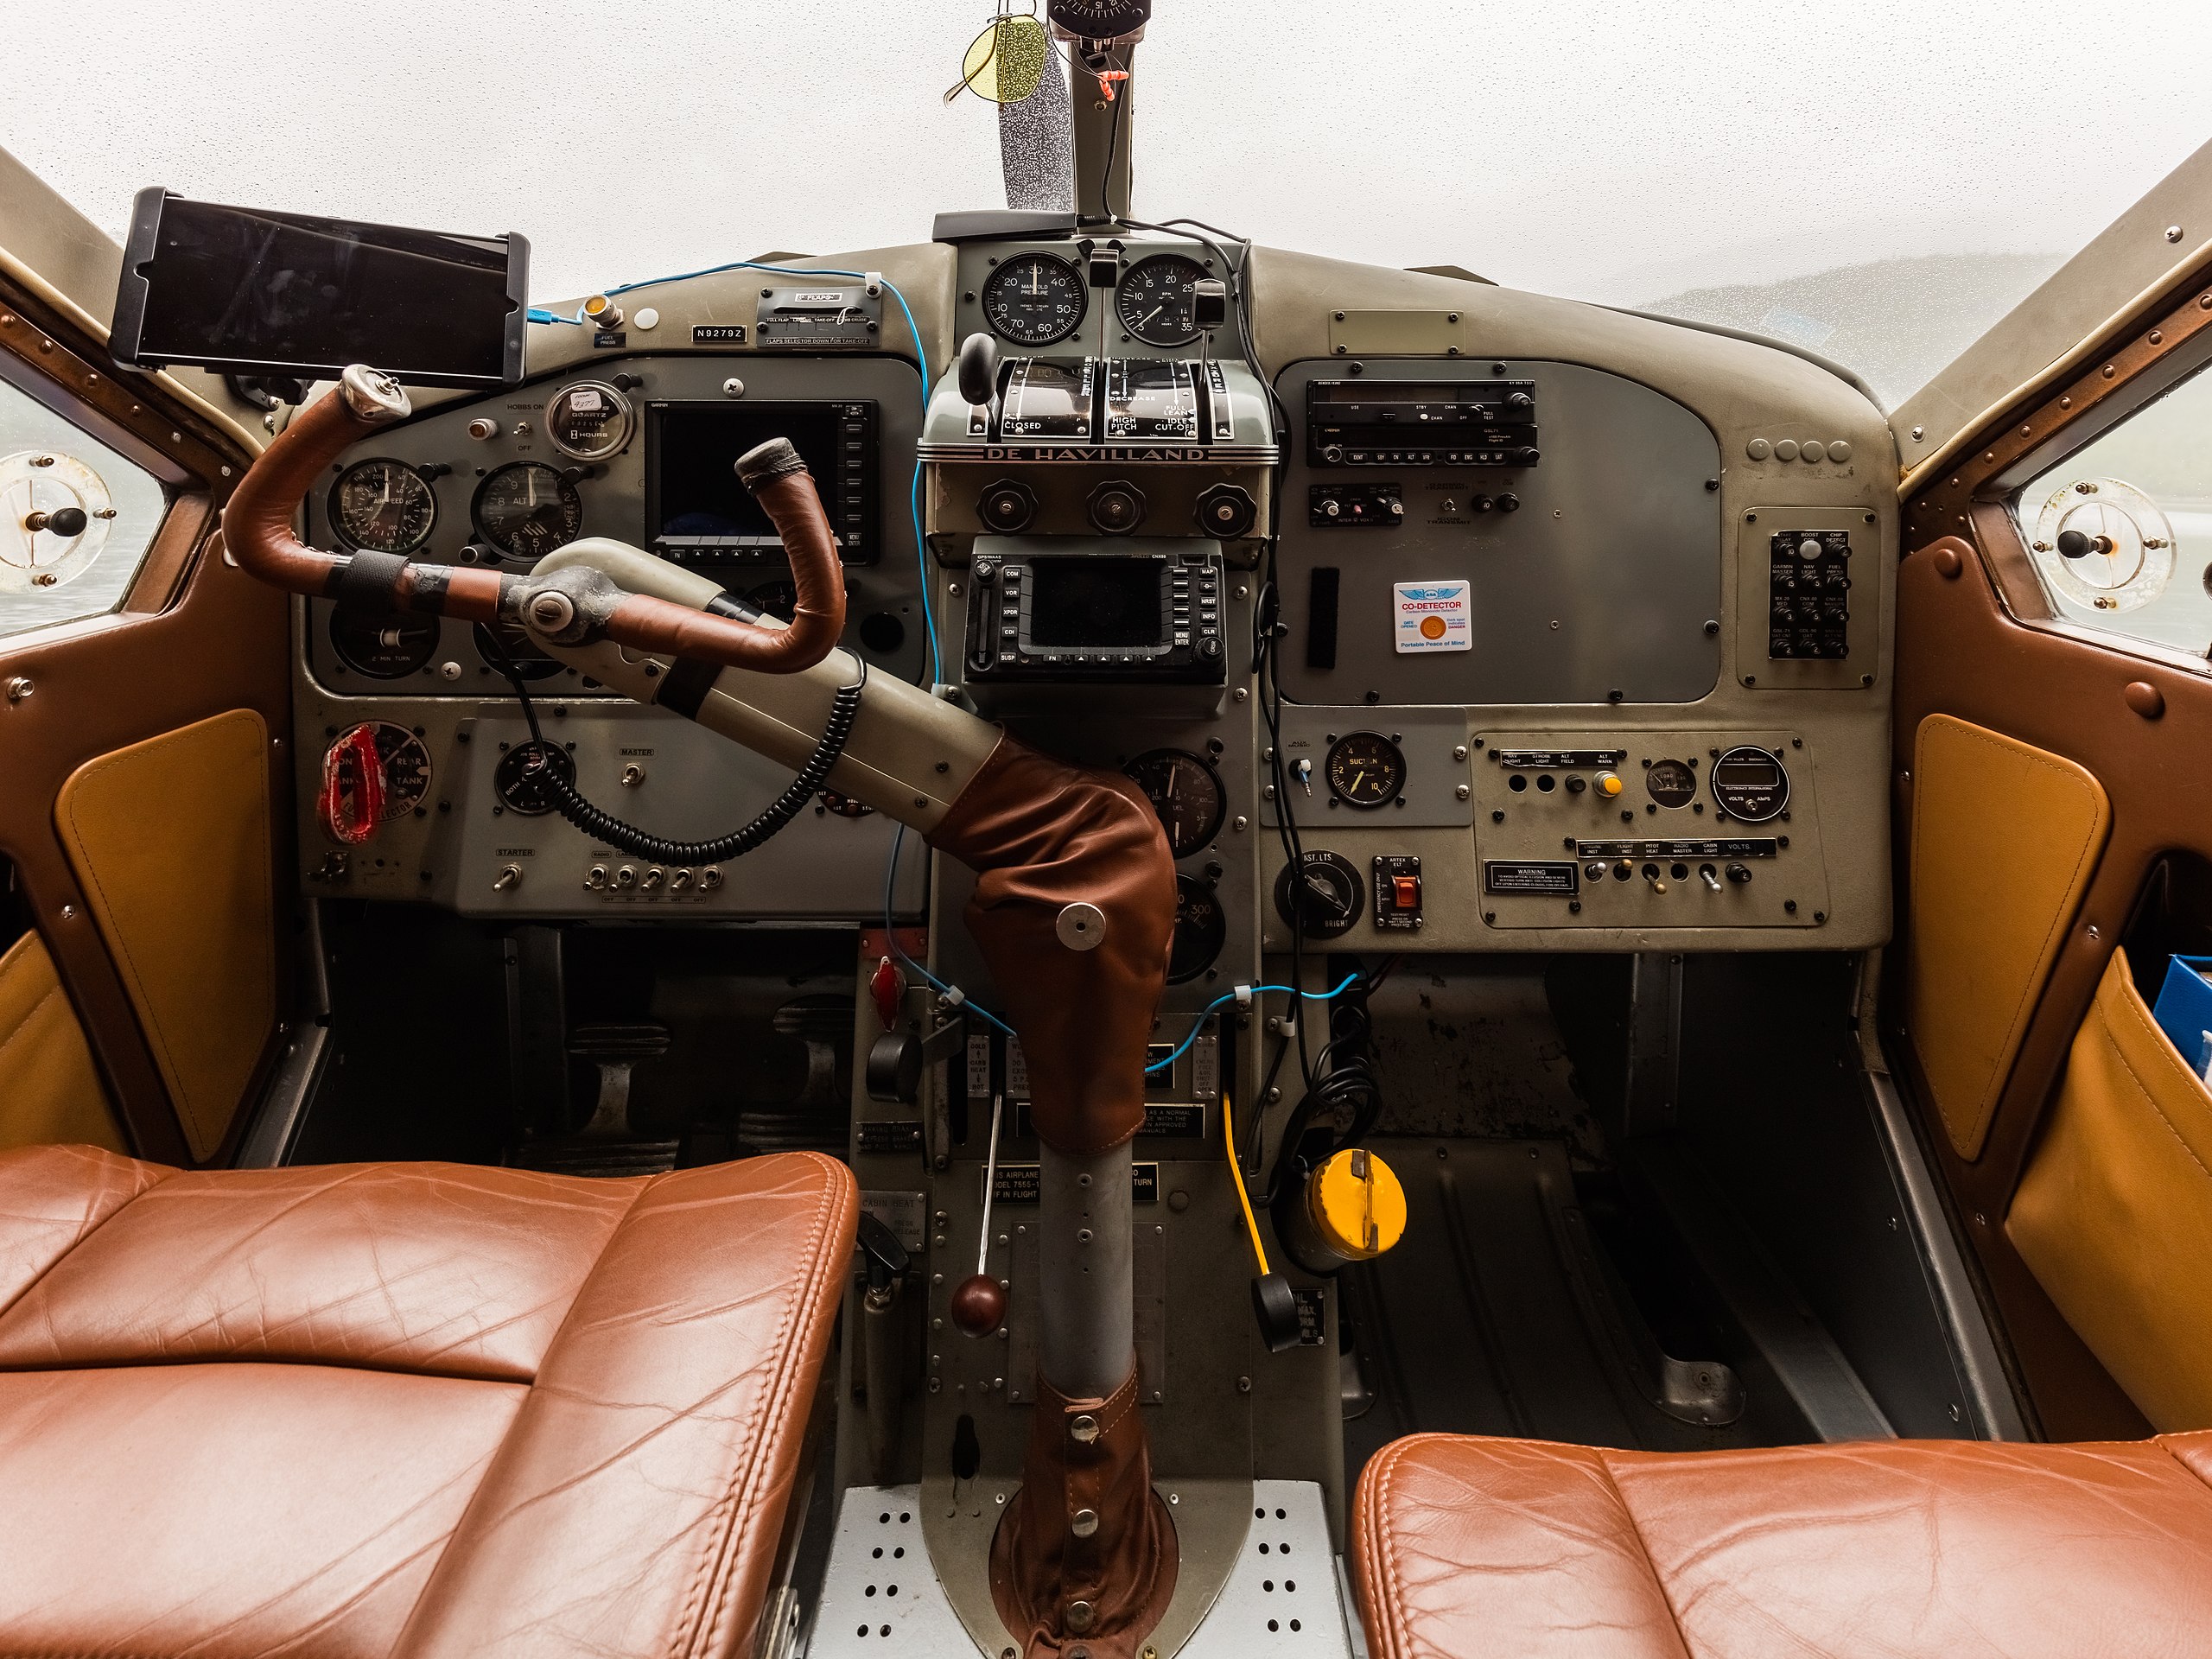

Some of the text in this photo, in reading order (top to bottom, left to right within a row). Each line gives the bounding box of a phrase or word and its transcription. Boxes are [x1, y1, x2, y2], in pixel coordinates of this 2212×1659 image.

[1004, 277, 1018, 287] 20
[1051, 278, 1066, 287] 40
[1146, 279, 1154, 288] 15
[1165, 275, 1177, 283] 20
[1182, 284, 1193, 293] 25
[997, 303, 1007, 312] 10
[1056, 304, 1071, 314] 50
[1136, 310, 1142, 319] 5
[1010, 319, 1024, 328] 70
[1038, 323, 1052, 333] 60
[1180, 322, 1192, 331] 35
[697, 329, 741, 338] N9279Z
[987, 448, 1204, 460] DE HAVILLAND
[511, 480, 518, 490] 9
[498, 497, 505, 506] 8
[563, 493, 571, 502] 2
[497, 516, 504, 525] 7
[566, 518, 573, 527] 3
[512, 531, 518, 541] 6
[553, 531, 561, 540] 4
[532, 538, 540, 548] 5
[1402, 601, 1462, 610] CO-DETECTOR
[505, 781, 521, 796] BOTH
[1191, 904, 1211, 915] 300
